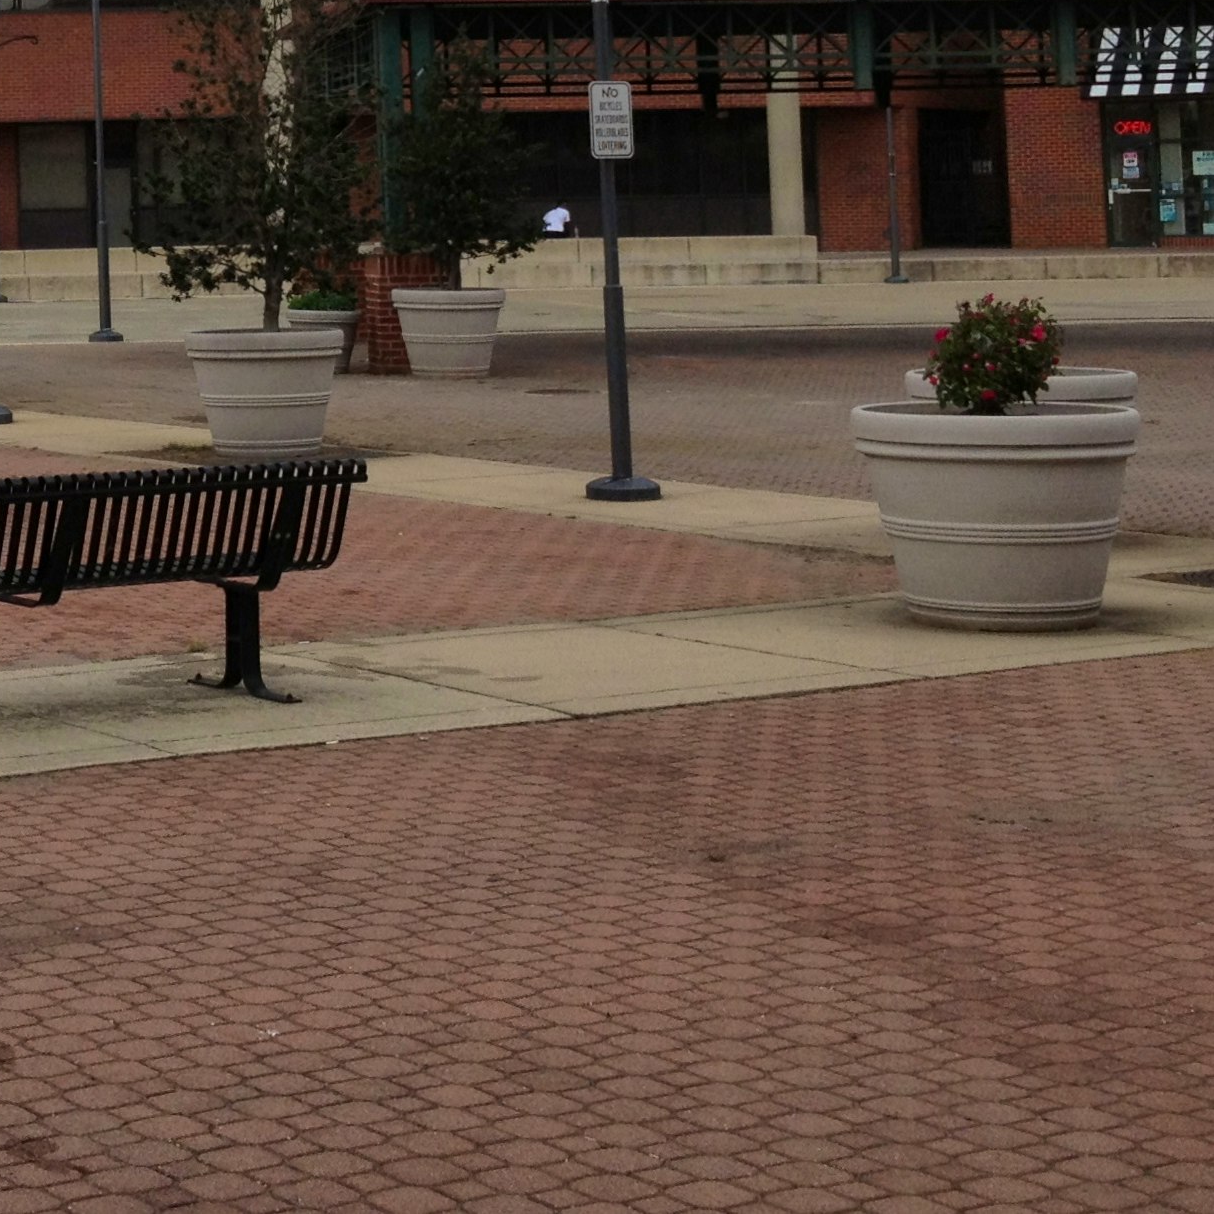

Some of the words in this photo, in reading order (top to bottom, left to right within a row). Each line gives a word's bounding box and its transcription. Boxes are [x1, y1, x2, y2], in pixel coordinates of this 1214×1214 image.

[601, 87, 619, 98] NO
[599, 101, 623, 111] BICYCLES
[595, 114, 628, 124] SKATEBOARDS
[595, 127, 629, 137] ROLLERBLADES
[1114, 121, 1152, 135] OPEN
[598, 140, 628, 151] LOITERING
